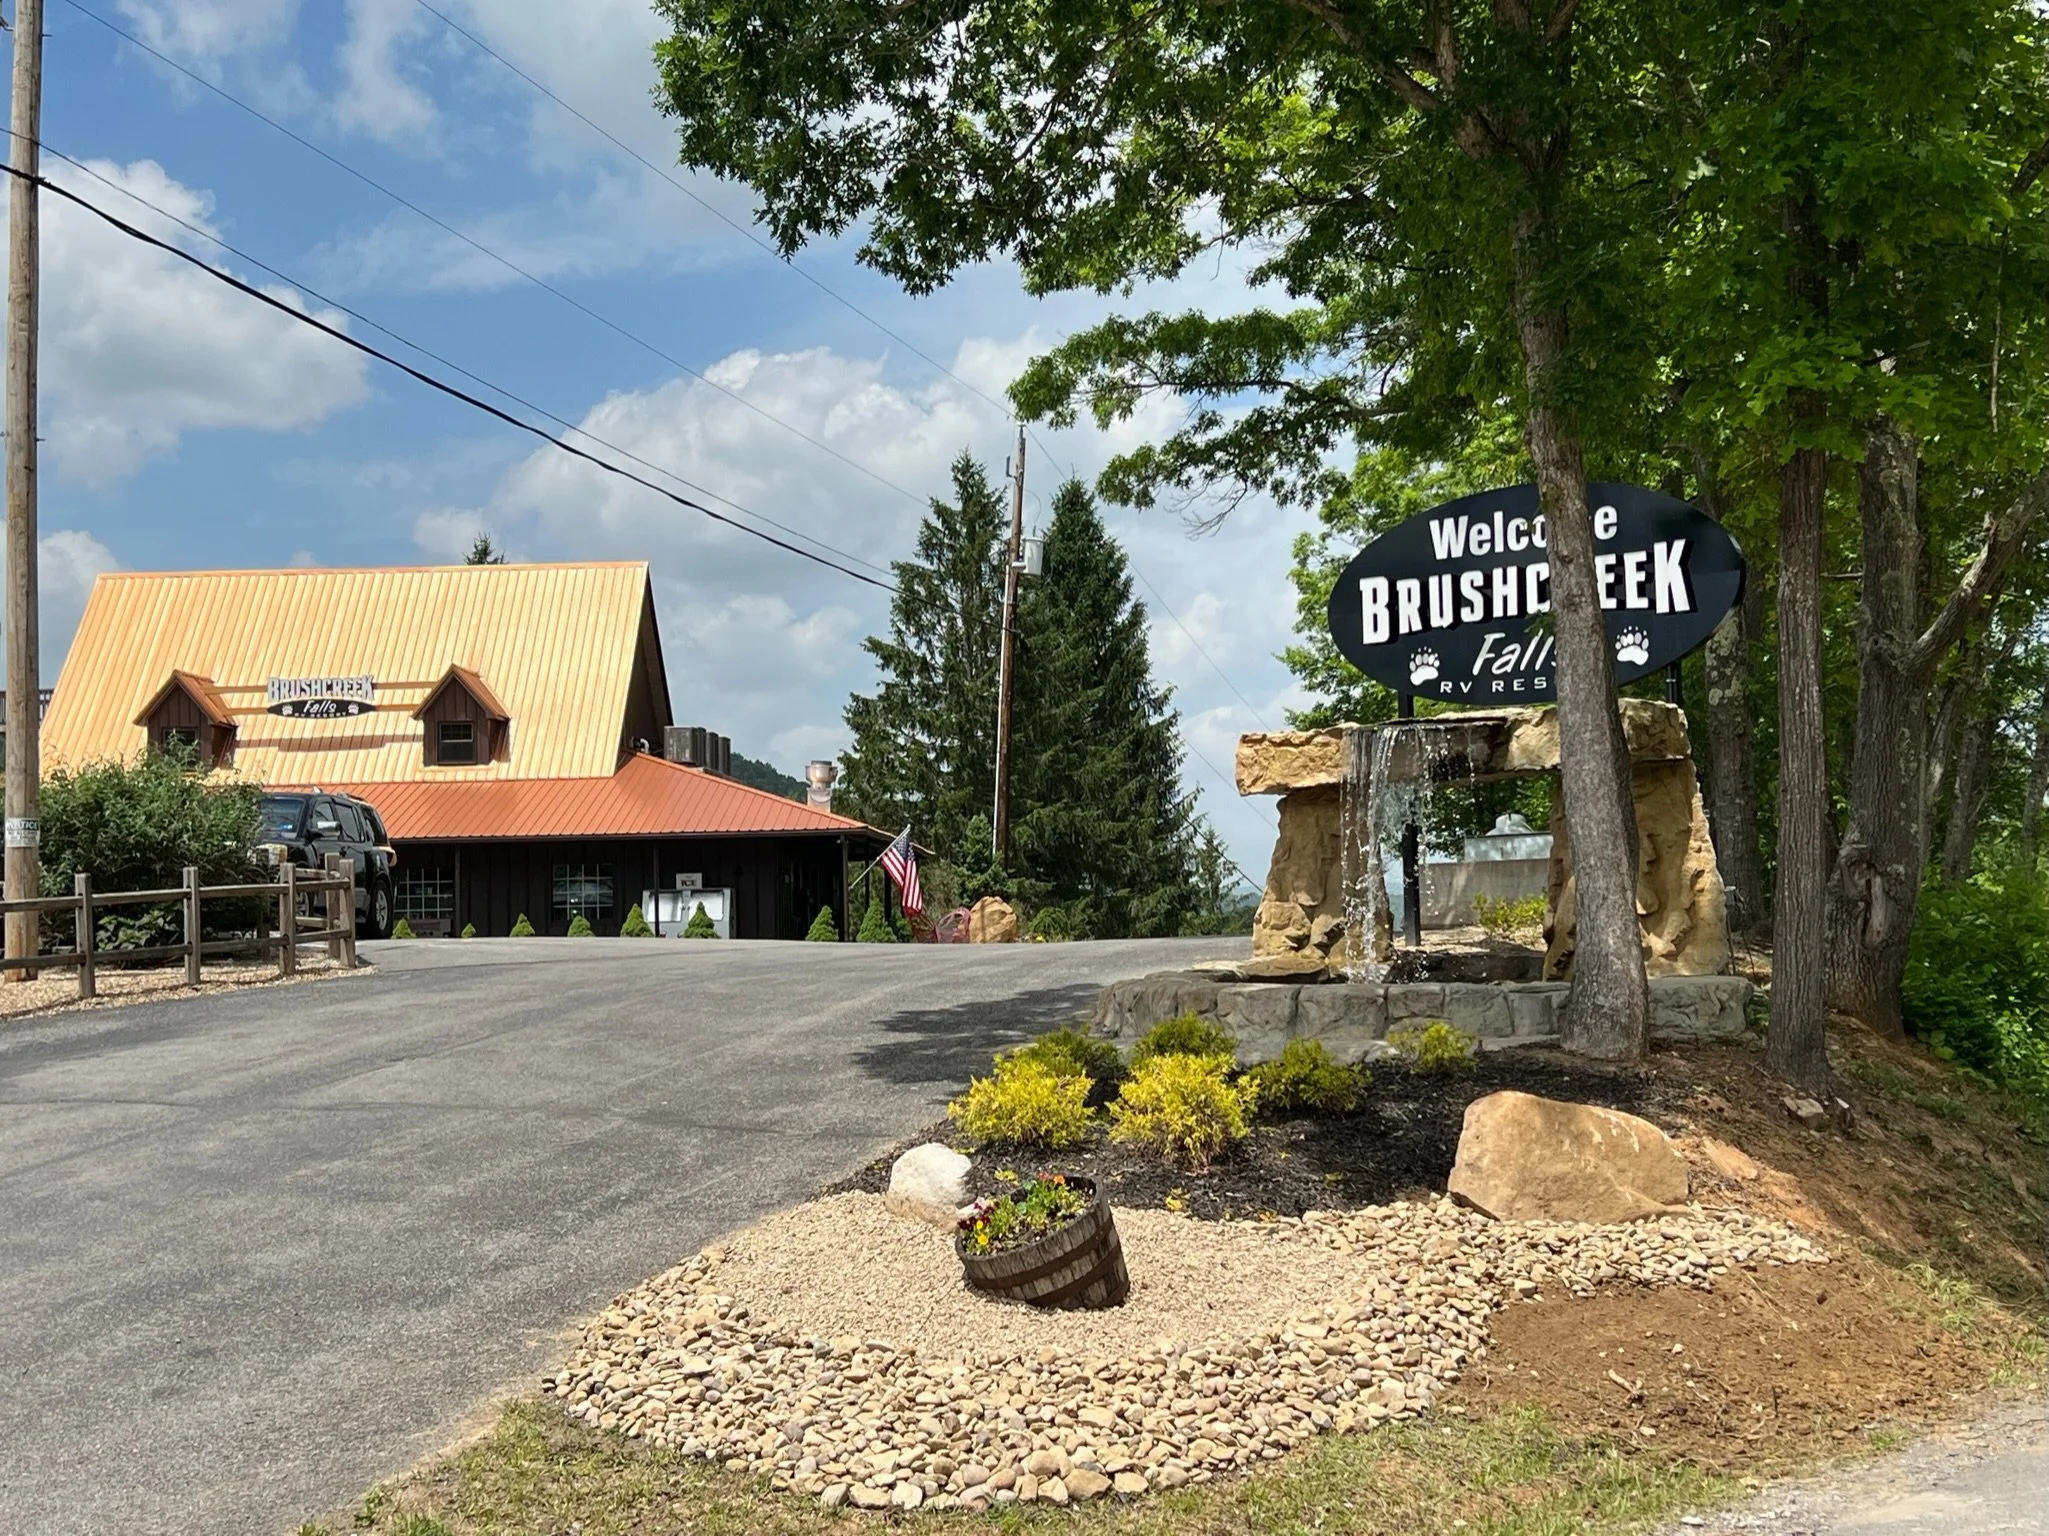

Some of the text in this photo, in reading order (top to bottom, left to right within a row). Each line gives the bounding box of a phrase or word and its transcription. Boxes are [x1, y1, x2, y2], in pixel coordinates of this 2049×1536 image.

[1429, 505, 1618, 561] Welcoe
[1359, 538, 1691, 645] BRUSHCEEK
[1472, 628, 1557, 677] Fall
[267, 674, 375, 702] BRUSHCREEK
[1440, 676, 1547, 694] RV RES
[303, 700, 337, 713] Falls
